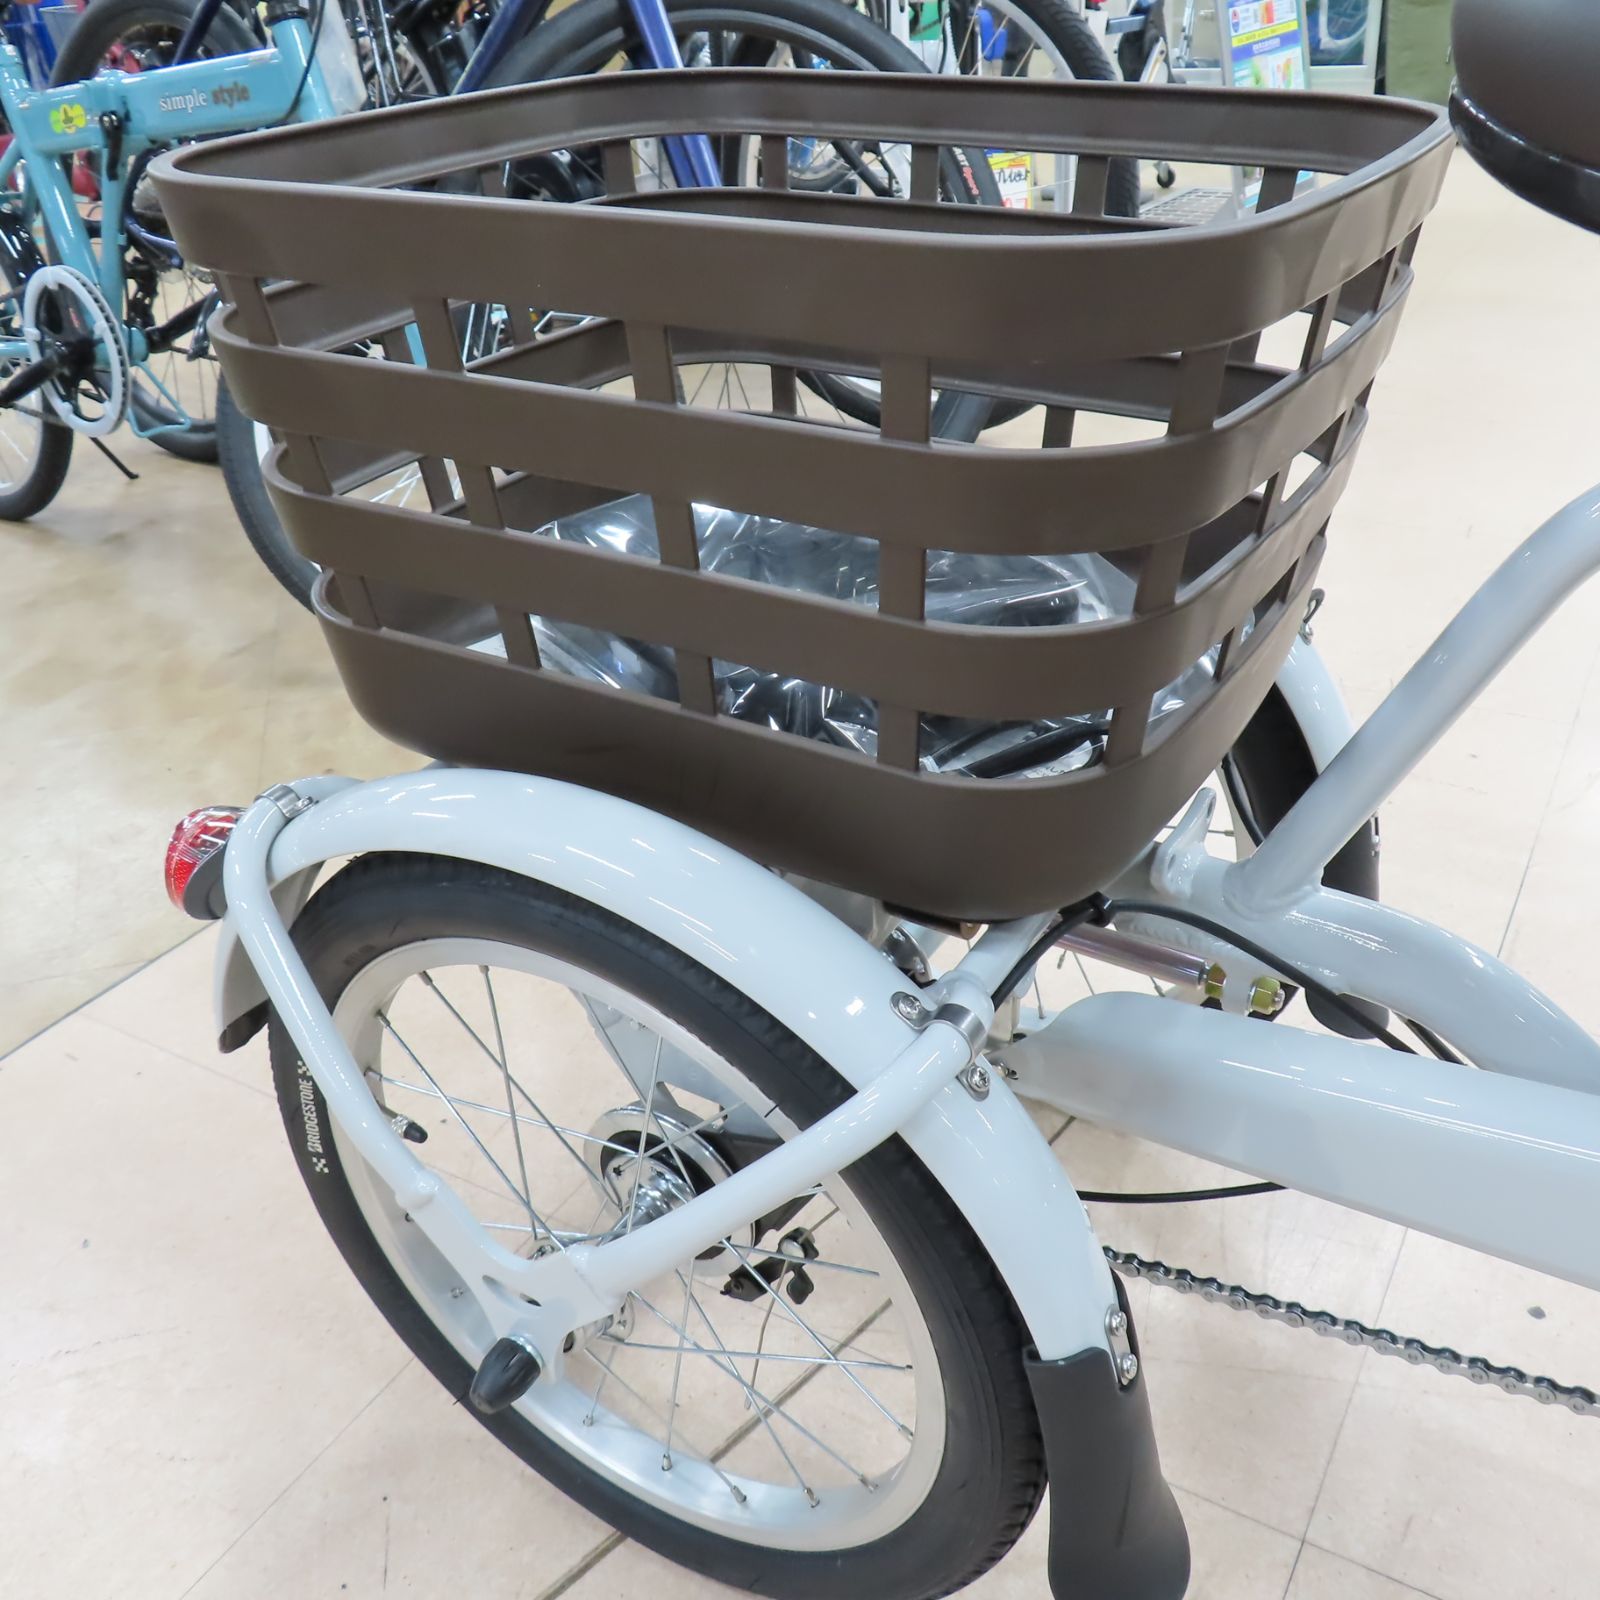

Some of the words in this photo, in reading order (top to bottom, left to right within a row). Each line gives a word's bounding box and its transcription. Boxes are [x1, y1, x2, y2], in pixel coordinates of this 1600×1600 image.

[159, 89, 207, 113] simple
[211, 82, 250, 108] style
[298, 1078, 324, 1154] BRIDGESTONE
